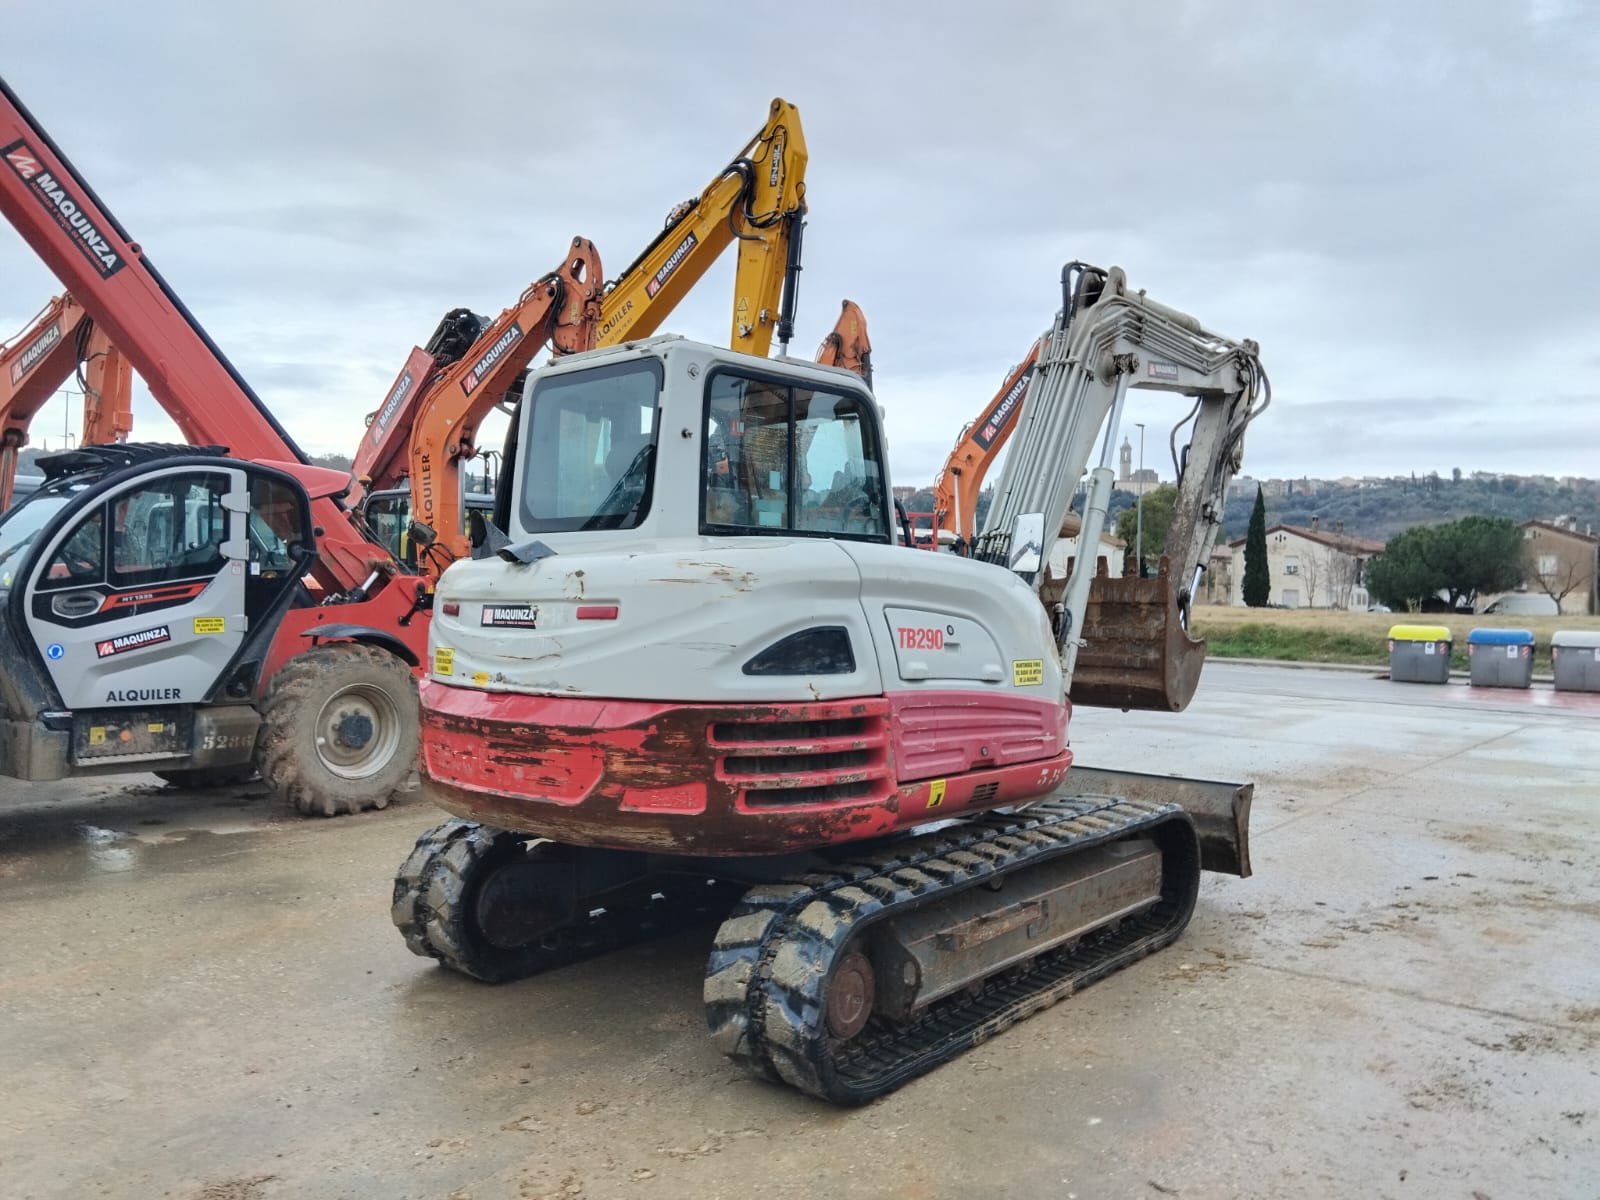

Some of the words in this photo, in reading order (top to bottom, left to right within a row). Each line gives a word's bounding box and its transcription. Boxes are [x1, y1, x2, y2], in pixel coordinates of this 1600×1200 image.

[36, 172, 118, 269] MAQUINZA
[656, 235, 695, 281] MAQUINZA
[596, 300, 634, 342] LQUILER
[21, 324, 60, 369] MAQUINZA
[474, 326, 520, 377] MAQUINZA
[379, 375, 412, 427] MAQUINZA
[991, 374, 1031, 426] MAQUINZA
[494, 608, 535, 620] MAQUINZA
[113, 627, 169, 648] MAQUINZA
[897, 627, 944, 650] TB290
[106, 688, 181, 702] ALQUILER
